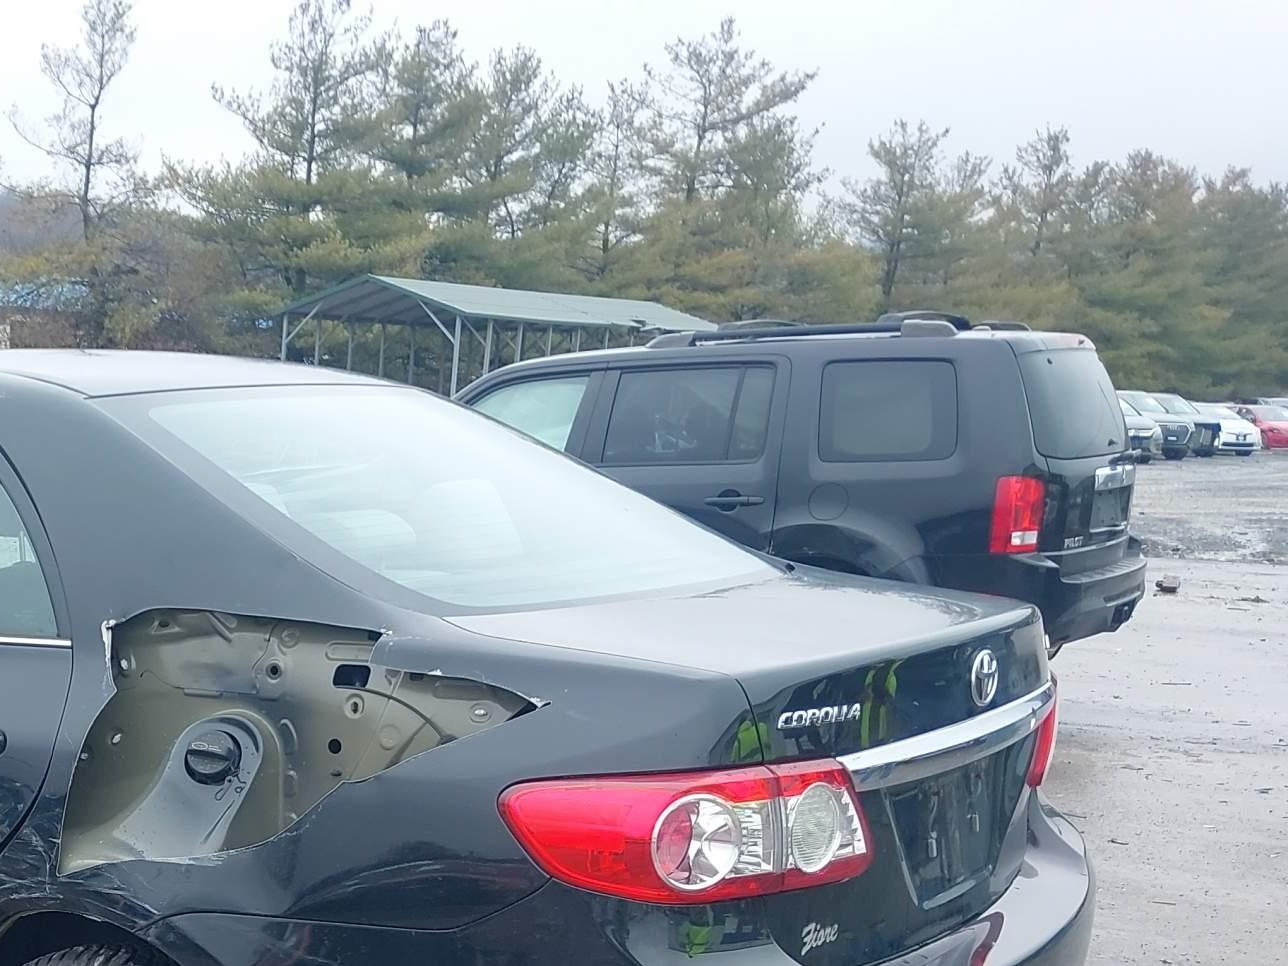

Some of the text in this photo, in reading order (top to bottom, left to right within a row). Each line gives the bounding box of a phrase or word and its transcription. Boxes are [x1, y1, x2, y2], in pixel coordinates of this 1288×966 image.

[1064, 535, 1084, 549] PILOT
[778, 702, 861, 729] COROLLA
[800, 921, 839, 957] Fiore
